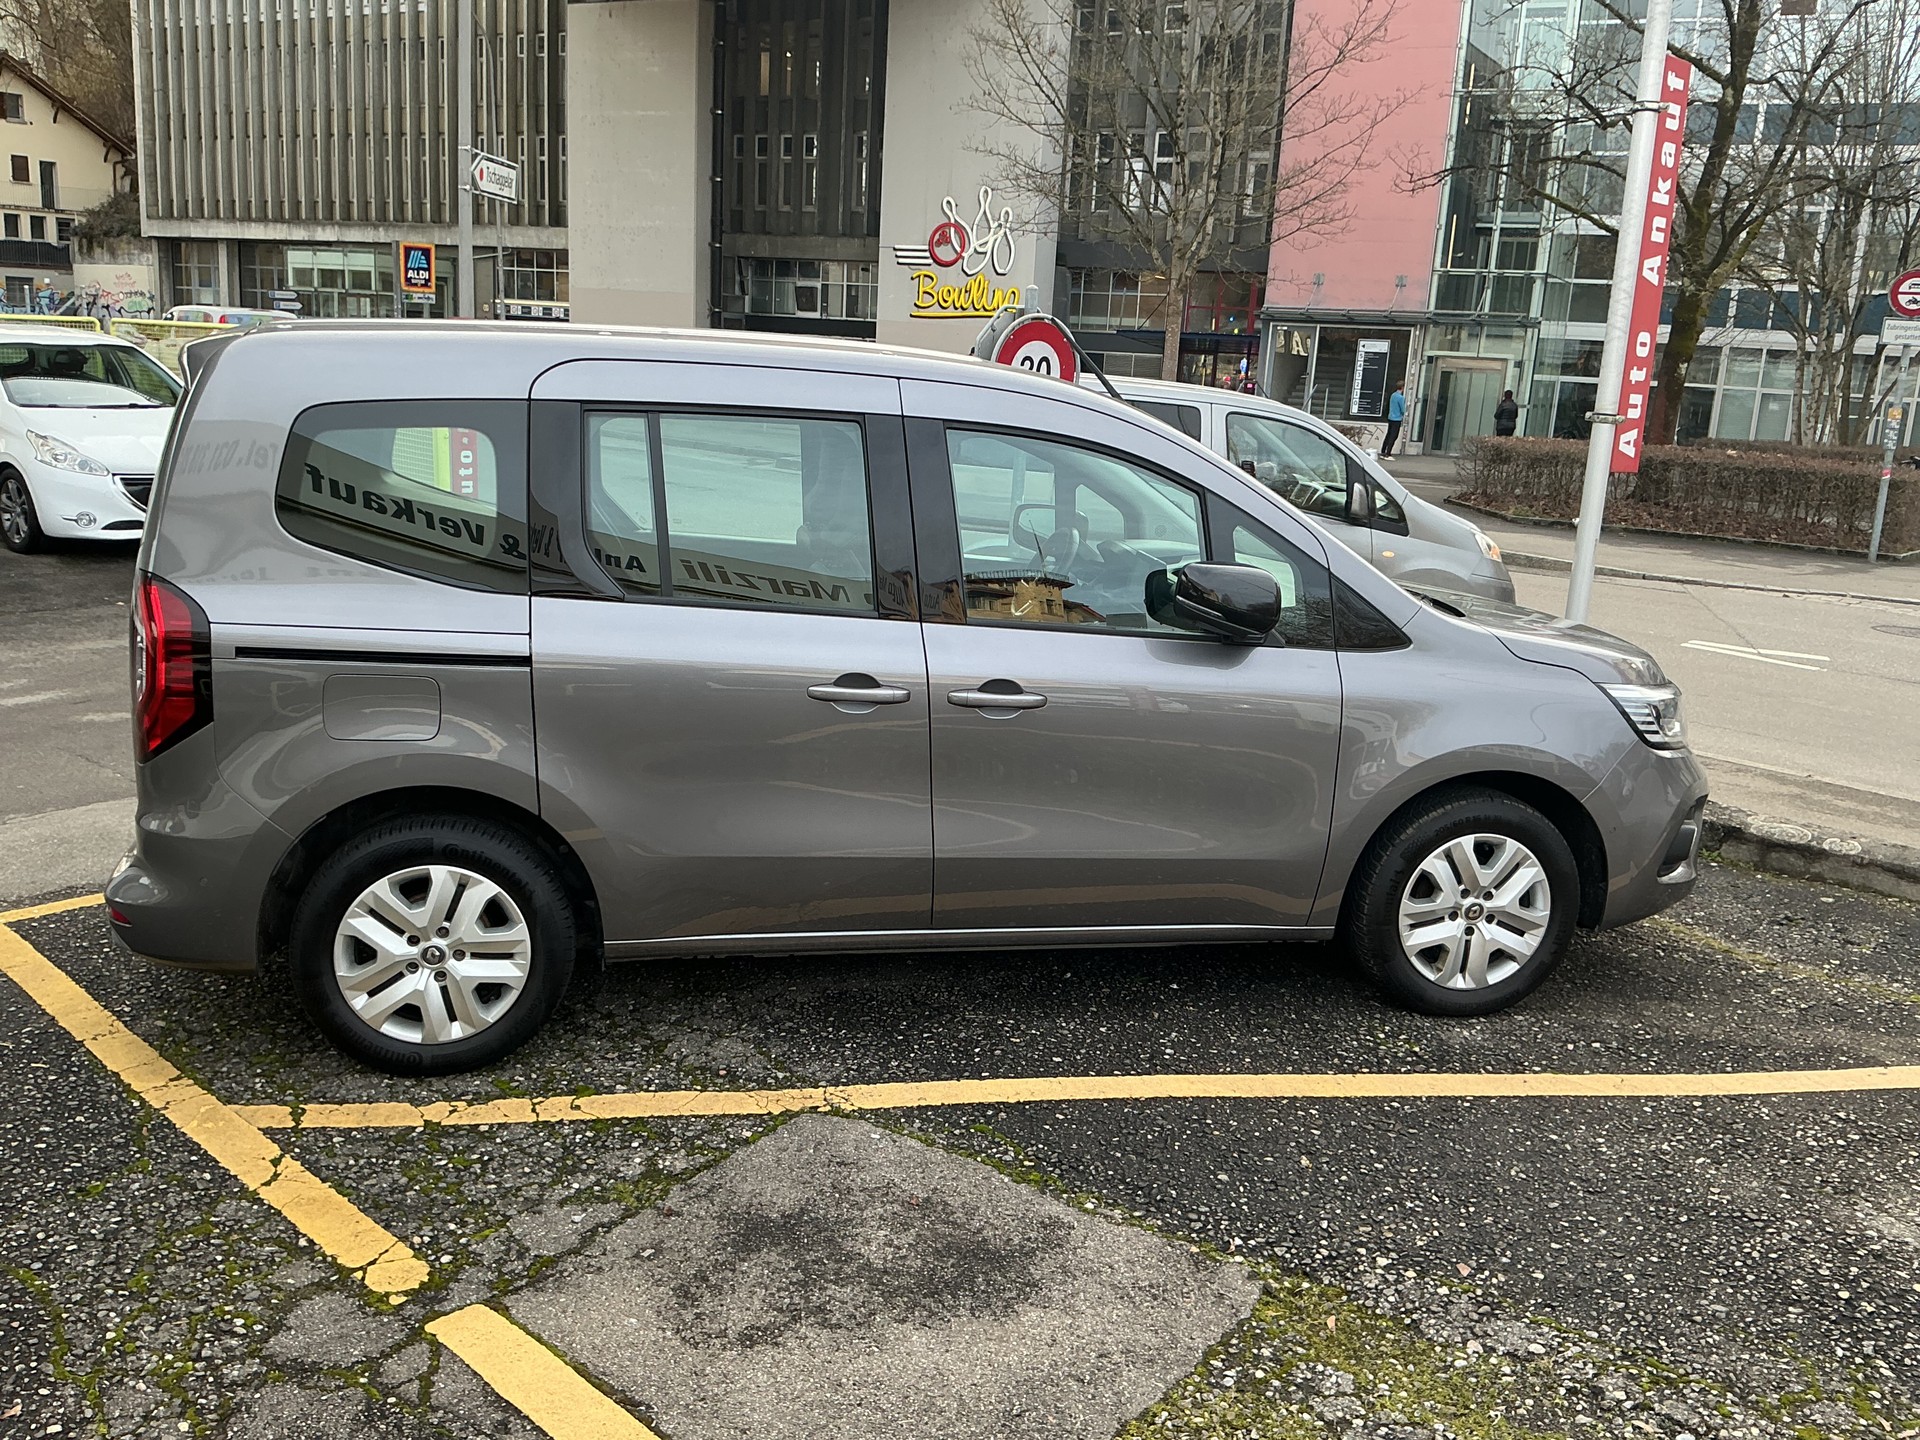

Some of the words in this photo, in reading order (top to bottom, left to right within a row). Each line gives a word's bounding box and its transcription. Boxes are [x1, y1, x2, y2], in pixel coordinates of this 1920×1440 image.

[407, 269, 429, 280] ALDI
[1618, 331, 1651, 458] Auto
[1642, 70, 1685, 287] Ankauf
[458, 449, 473, 494] uto
